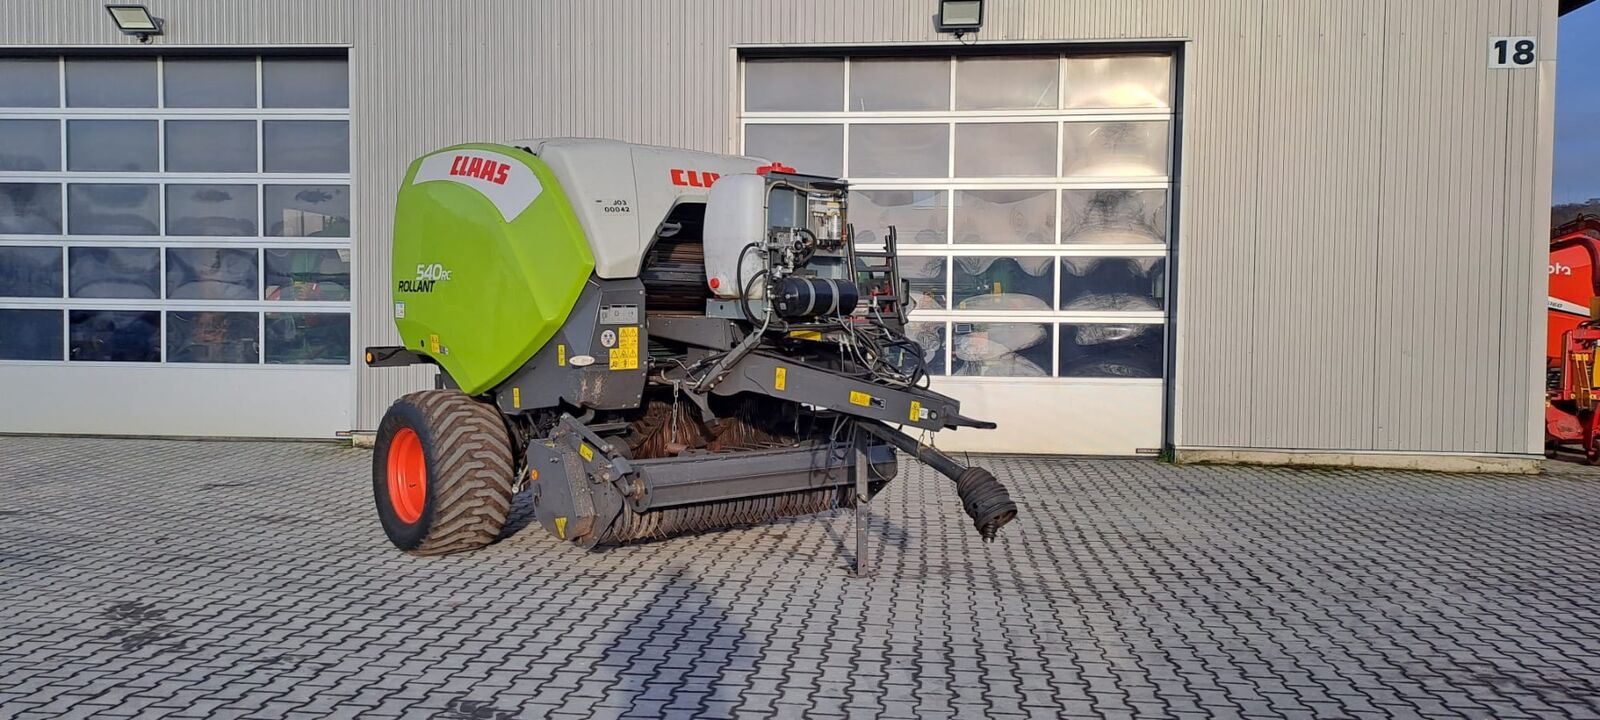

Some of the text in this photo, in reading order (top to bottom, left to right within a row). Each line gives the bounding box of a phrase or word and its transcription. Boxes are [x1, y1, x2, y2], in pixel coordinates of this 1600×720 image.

[1494, 40, 1535, 65] 18
[450, 155, 511, 185] CLAAS
[398, 280, 435, 293] ROLLANT
